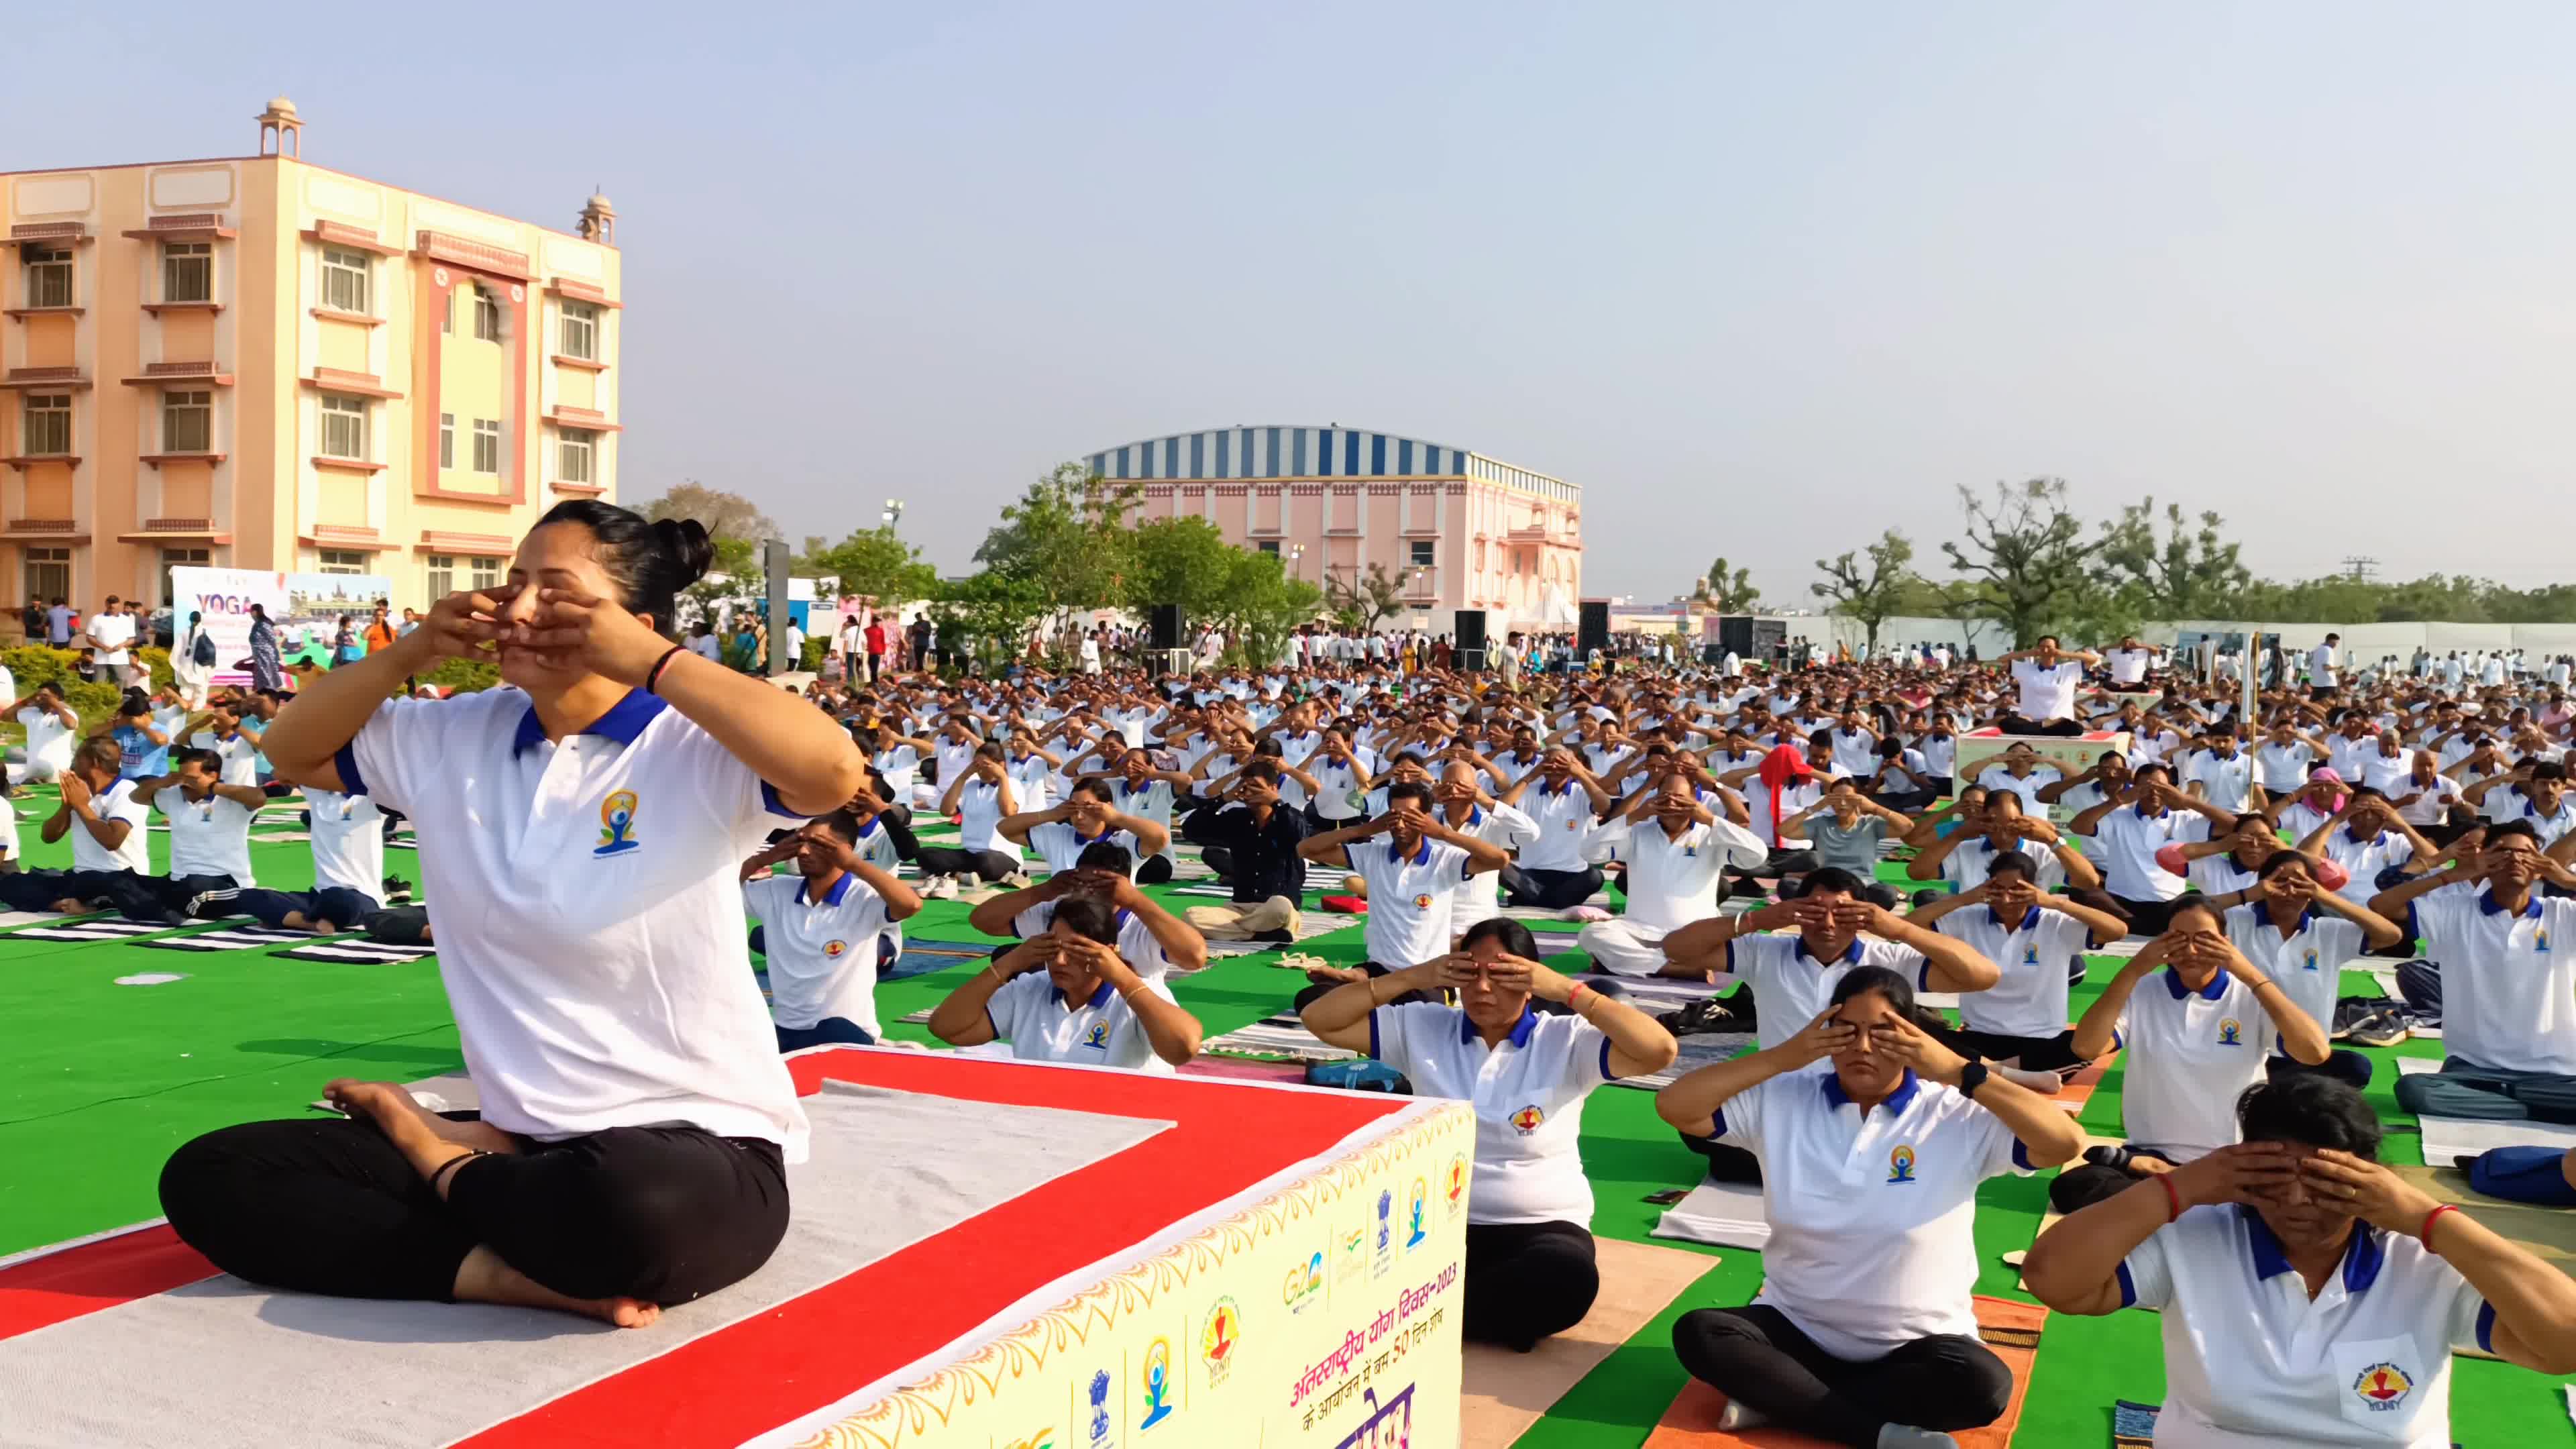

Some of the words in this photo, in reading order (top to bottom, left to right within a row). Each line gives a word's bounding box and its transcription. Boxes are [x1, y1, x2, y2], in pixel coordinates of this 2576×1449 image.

[196, 594, 252, 614] YOGA
[1369, 1308, 1395, 1344] योग
[1302, 1404, 1315, 1432] के
[1318, 1374, 1360, 1420] आयोजन
[1363, 1358, 1372, 1385] में
[1374, 1350, 1390, 1375] बस
[1393, 1330, 1409, 1363] 50
[1412, 1320, 1428, 1347] दिन
[1430, 1307, 1444, 1333] शेष
